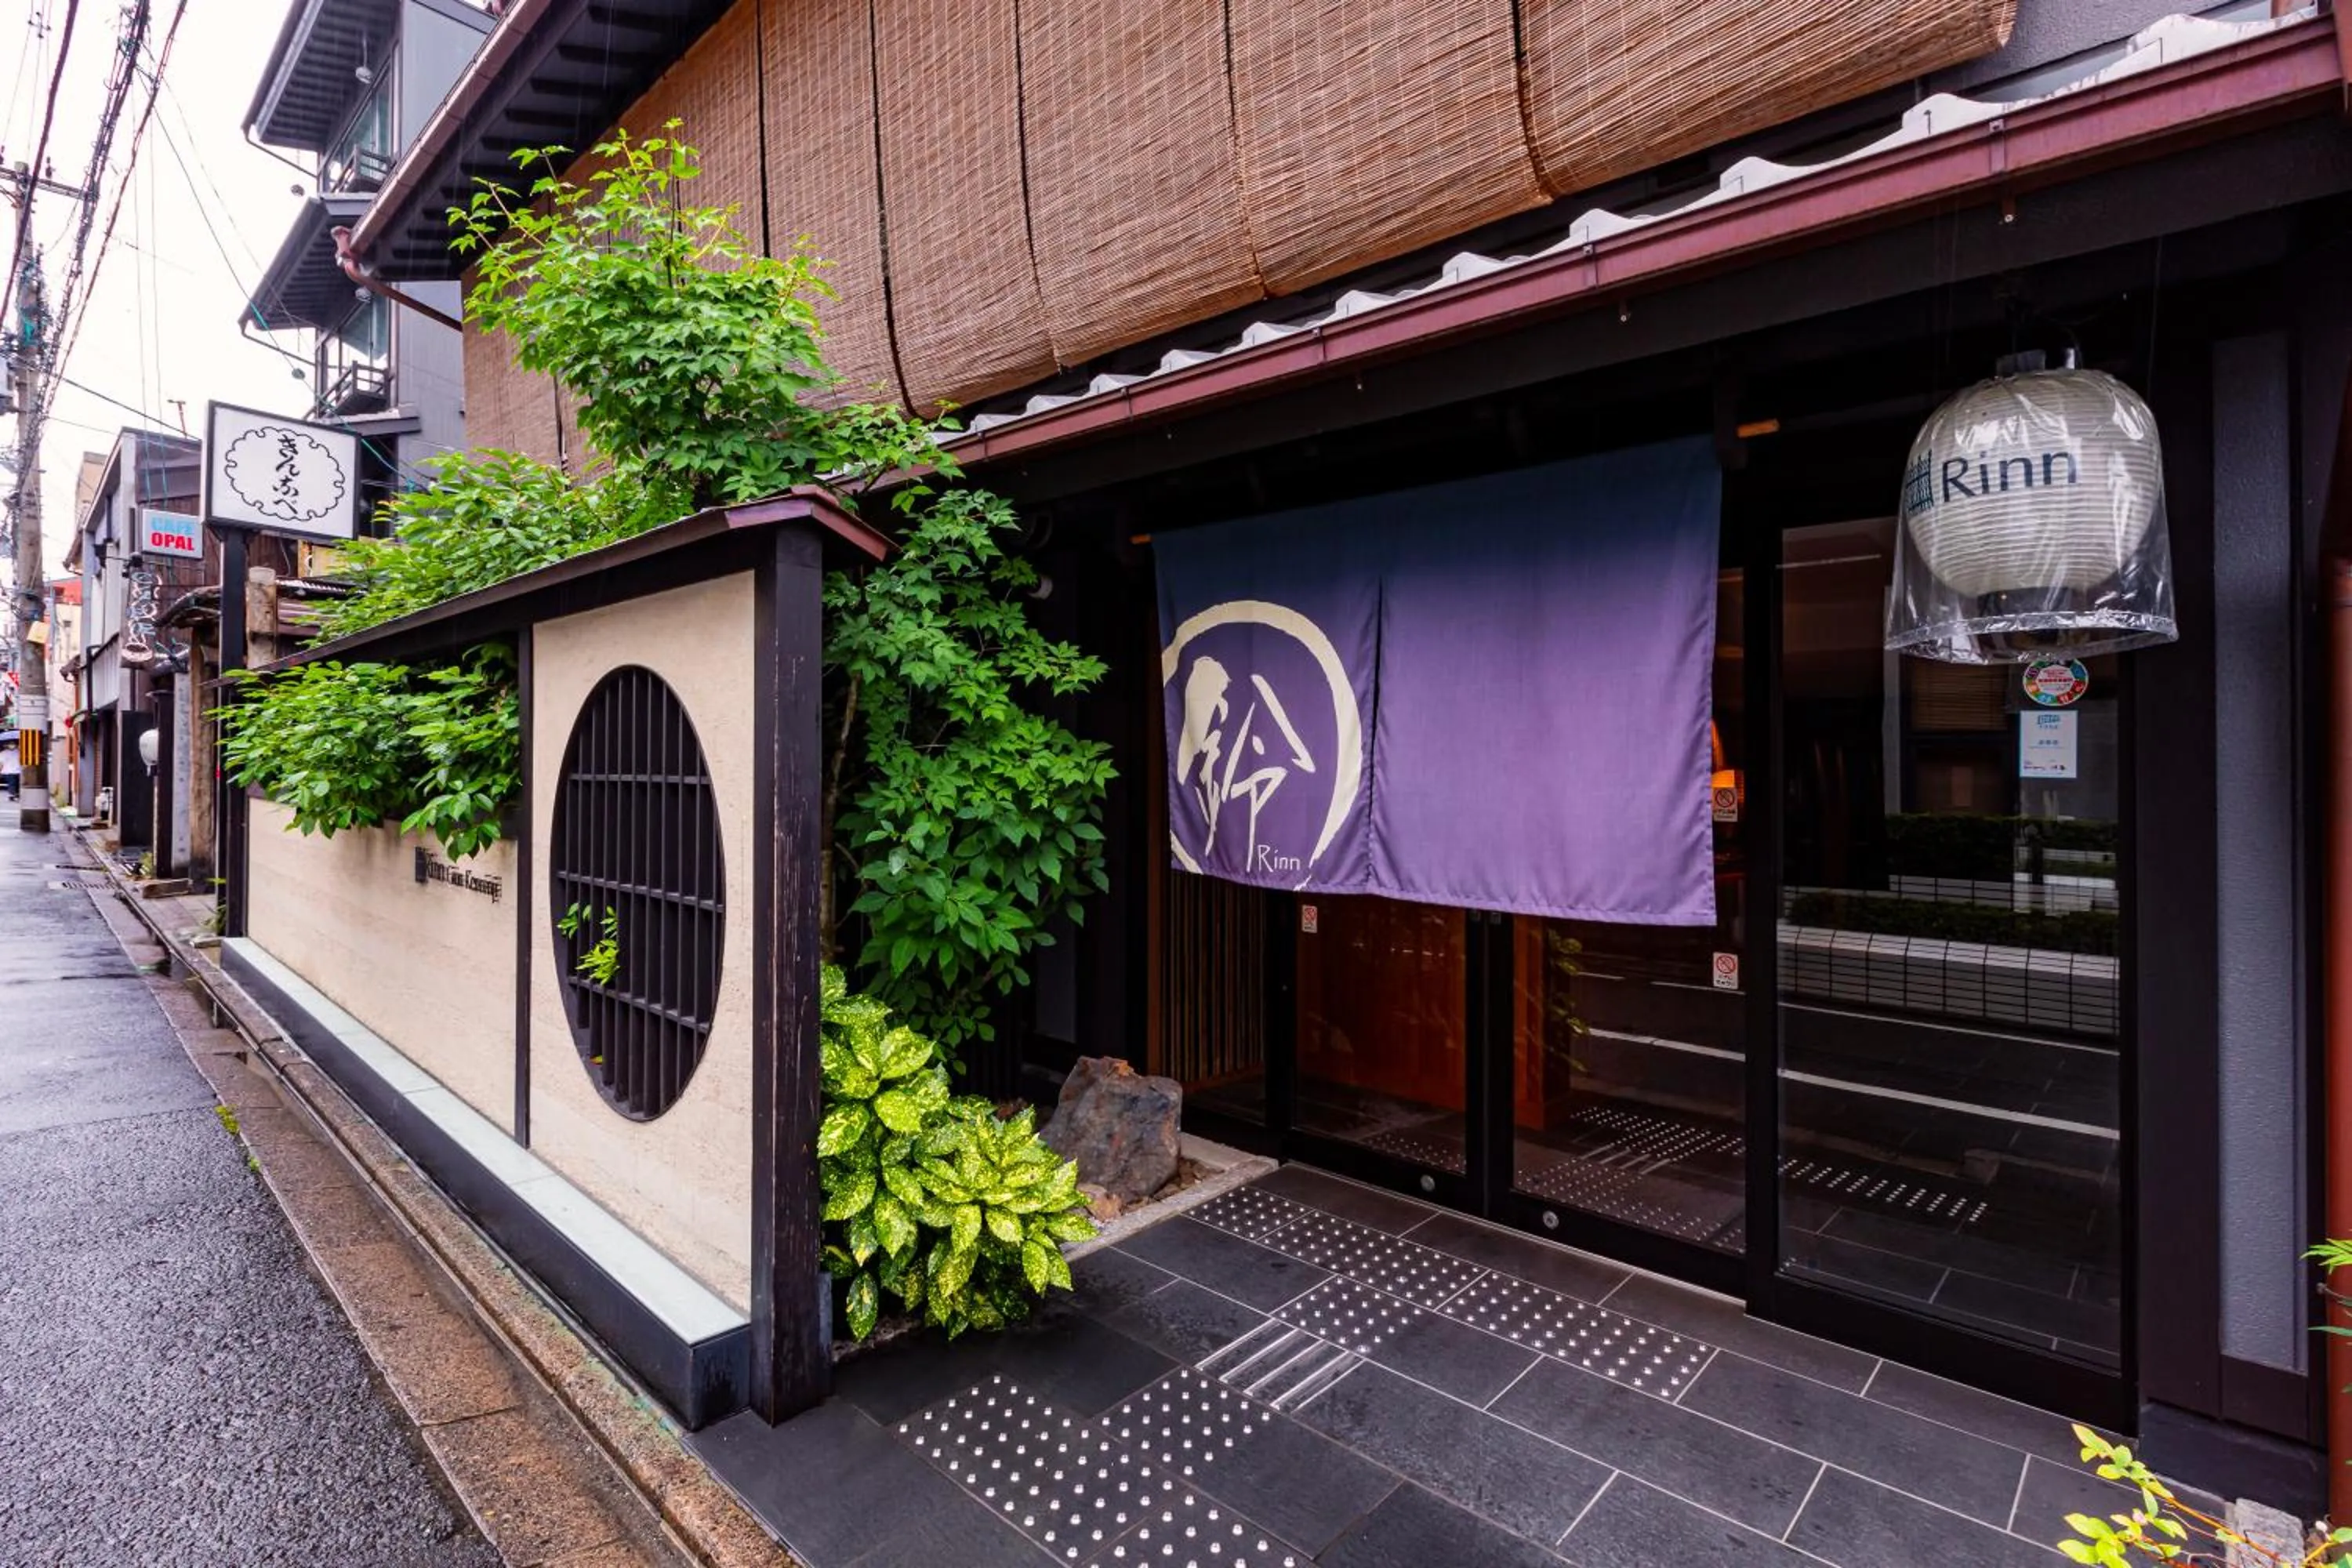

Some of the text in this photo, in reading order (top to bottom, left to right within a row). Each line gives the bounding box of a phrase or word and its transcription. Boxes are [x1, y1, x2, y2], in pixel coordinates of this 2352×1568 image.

[1942, 451, 2077, 503] Rinn
[151, 532, 195, 550] OPAL
[1177, 656, 1316, 873] 鈴
[1258, 844, 1301, 873] Rinn
